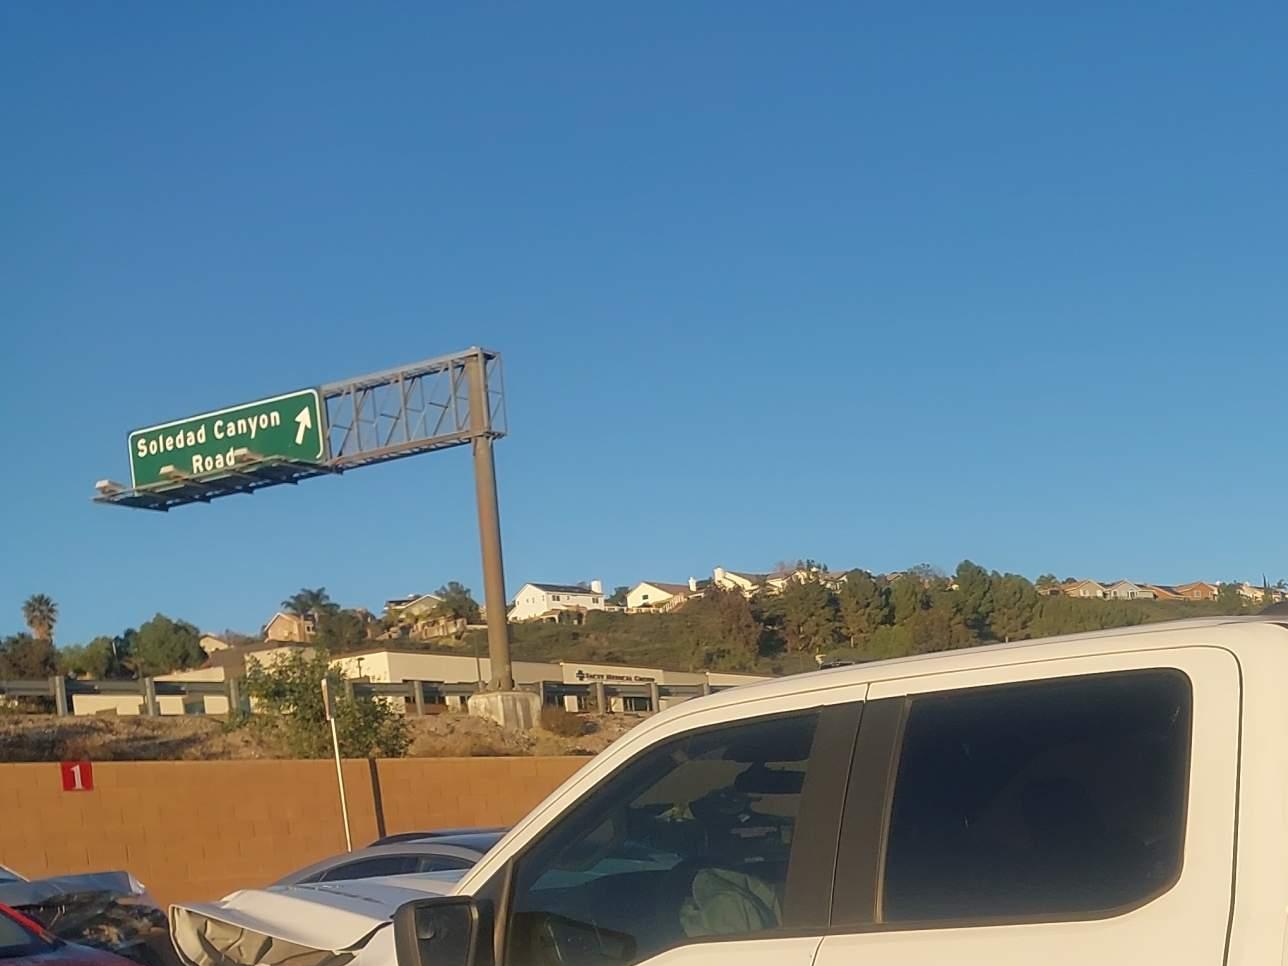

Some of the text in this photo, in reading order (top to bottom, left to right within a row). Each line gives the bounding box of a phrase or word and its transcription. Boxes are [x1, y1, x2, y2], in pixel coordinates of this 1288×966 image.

[137, 411, 281, 458] Soledad Canyon
[191, 447, 236, 474] Road
[70, 764, 84, 790] 1
